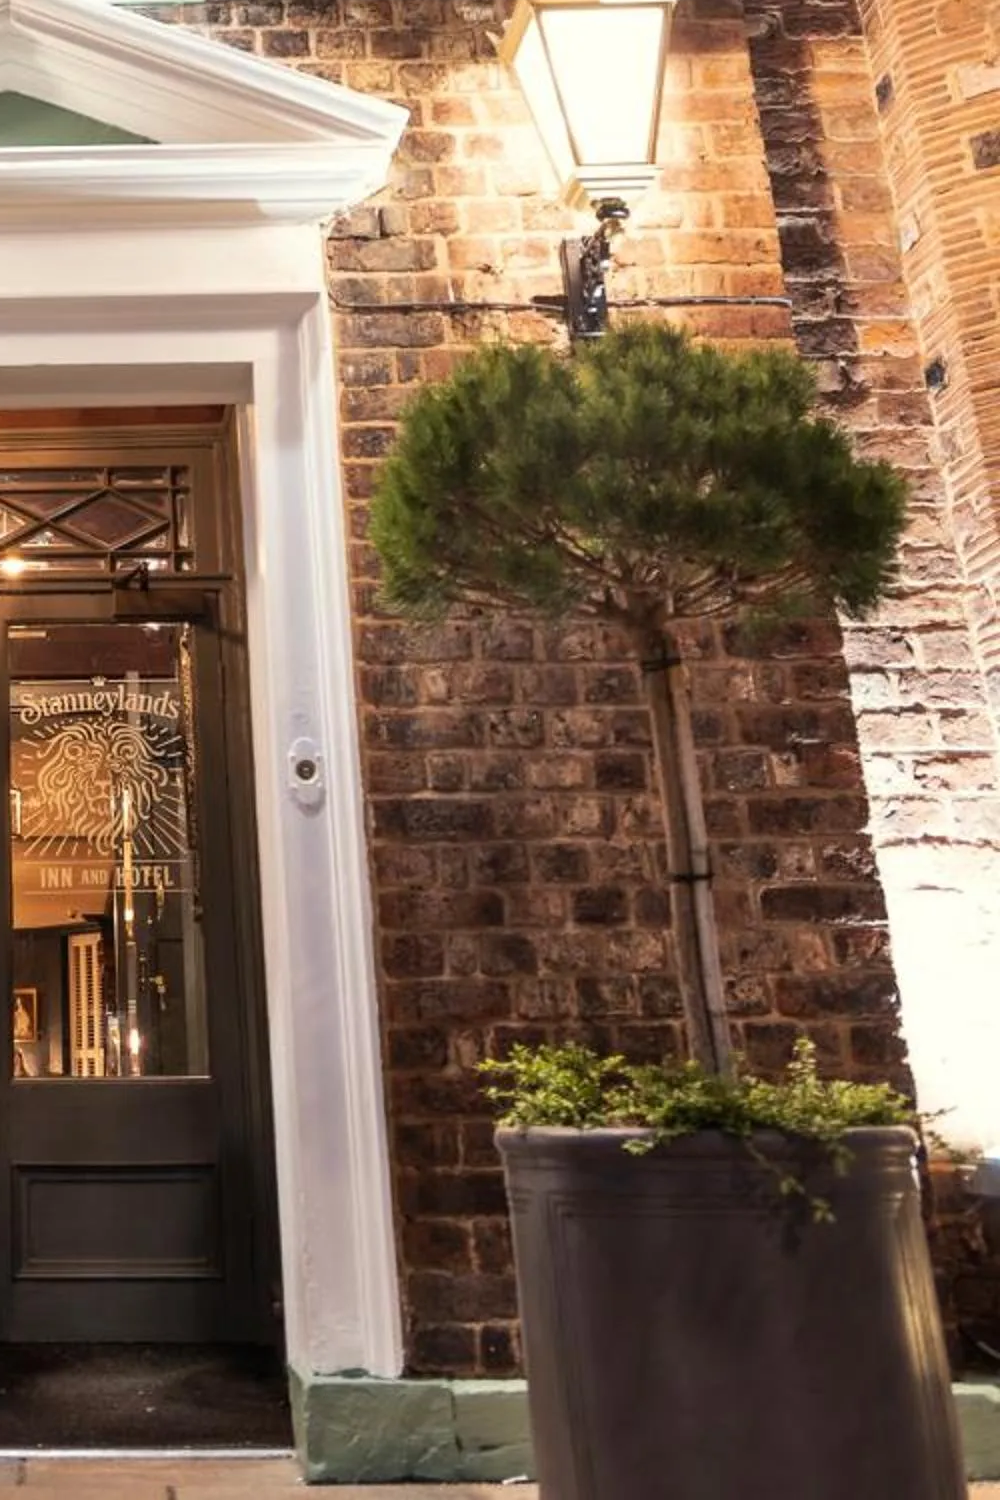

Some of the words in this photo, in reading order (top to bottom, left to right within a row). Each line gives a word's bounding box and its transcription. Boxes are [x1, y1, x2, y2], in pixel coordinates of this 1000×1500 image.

[20, 684, 180, 725] Stanneylands
[40, 866, 73, 889] INN
[81, 868, 109, 885] AND
[115, 865, 175, 888] HOTEL
